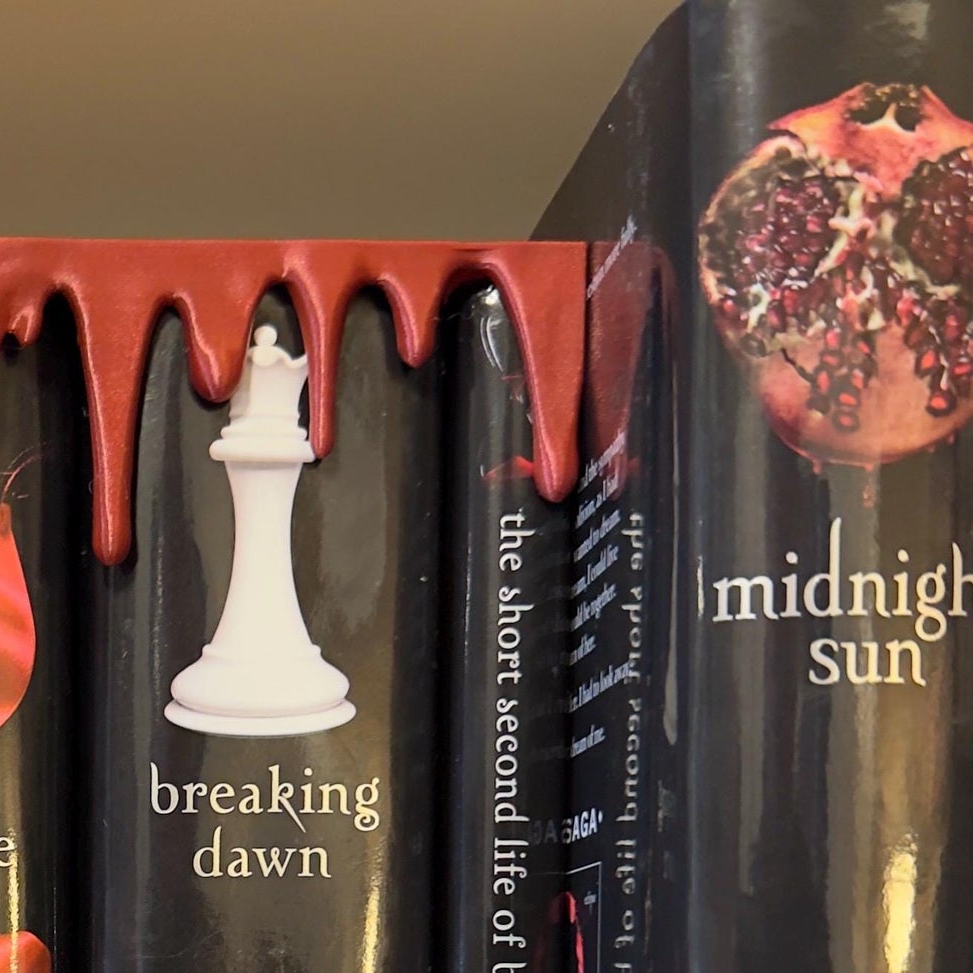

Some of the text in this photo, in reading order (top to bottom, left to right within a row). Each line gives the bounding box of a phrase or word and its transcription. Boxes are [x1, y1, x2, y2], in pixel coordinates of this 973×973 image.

[499, 508, 536, 571] the
[712, 516, 973, 642] midnigh
[496, 586, 535, 685] short
[808, 637, 927, 687] sun
[493, 697, 530, 823] second
[150, 761, 381, 833] breaking
[192, 825, 332, 878] dawn
[492, 837, 530, 895] life
[491, 909, 527, 949] of
